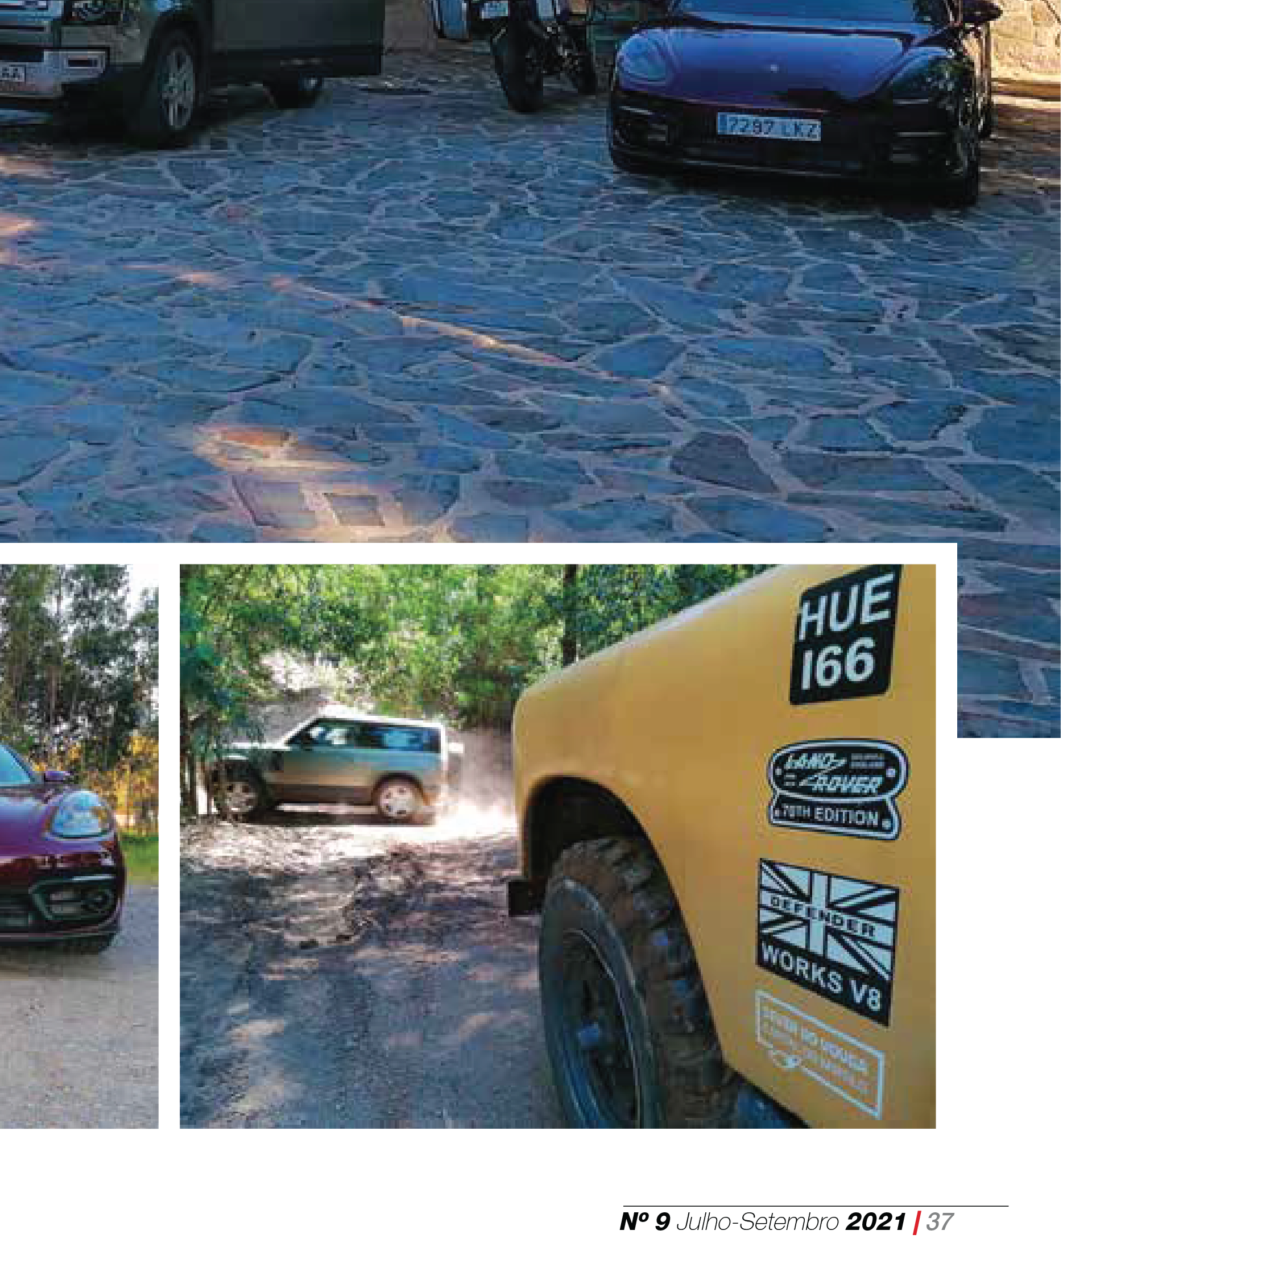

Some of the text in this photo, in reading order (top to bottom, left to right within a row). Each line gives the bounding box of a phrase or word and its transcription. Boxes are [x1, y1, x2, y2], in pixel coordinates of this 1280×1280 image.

[799, 572, 895, 641] HUE
[814, 807, 879, 828] EDITION
[770, 894, 877, 938] DEFENDER
[761, 941, 882, 1012] WORKS V8
[655, 1212, 670, 1231] 9
[677, 1212, 839, 1230] Julho-Setembro
[845, 1212, 905, 1231] 2021
[927, 1213, 954, 1230] 37
